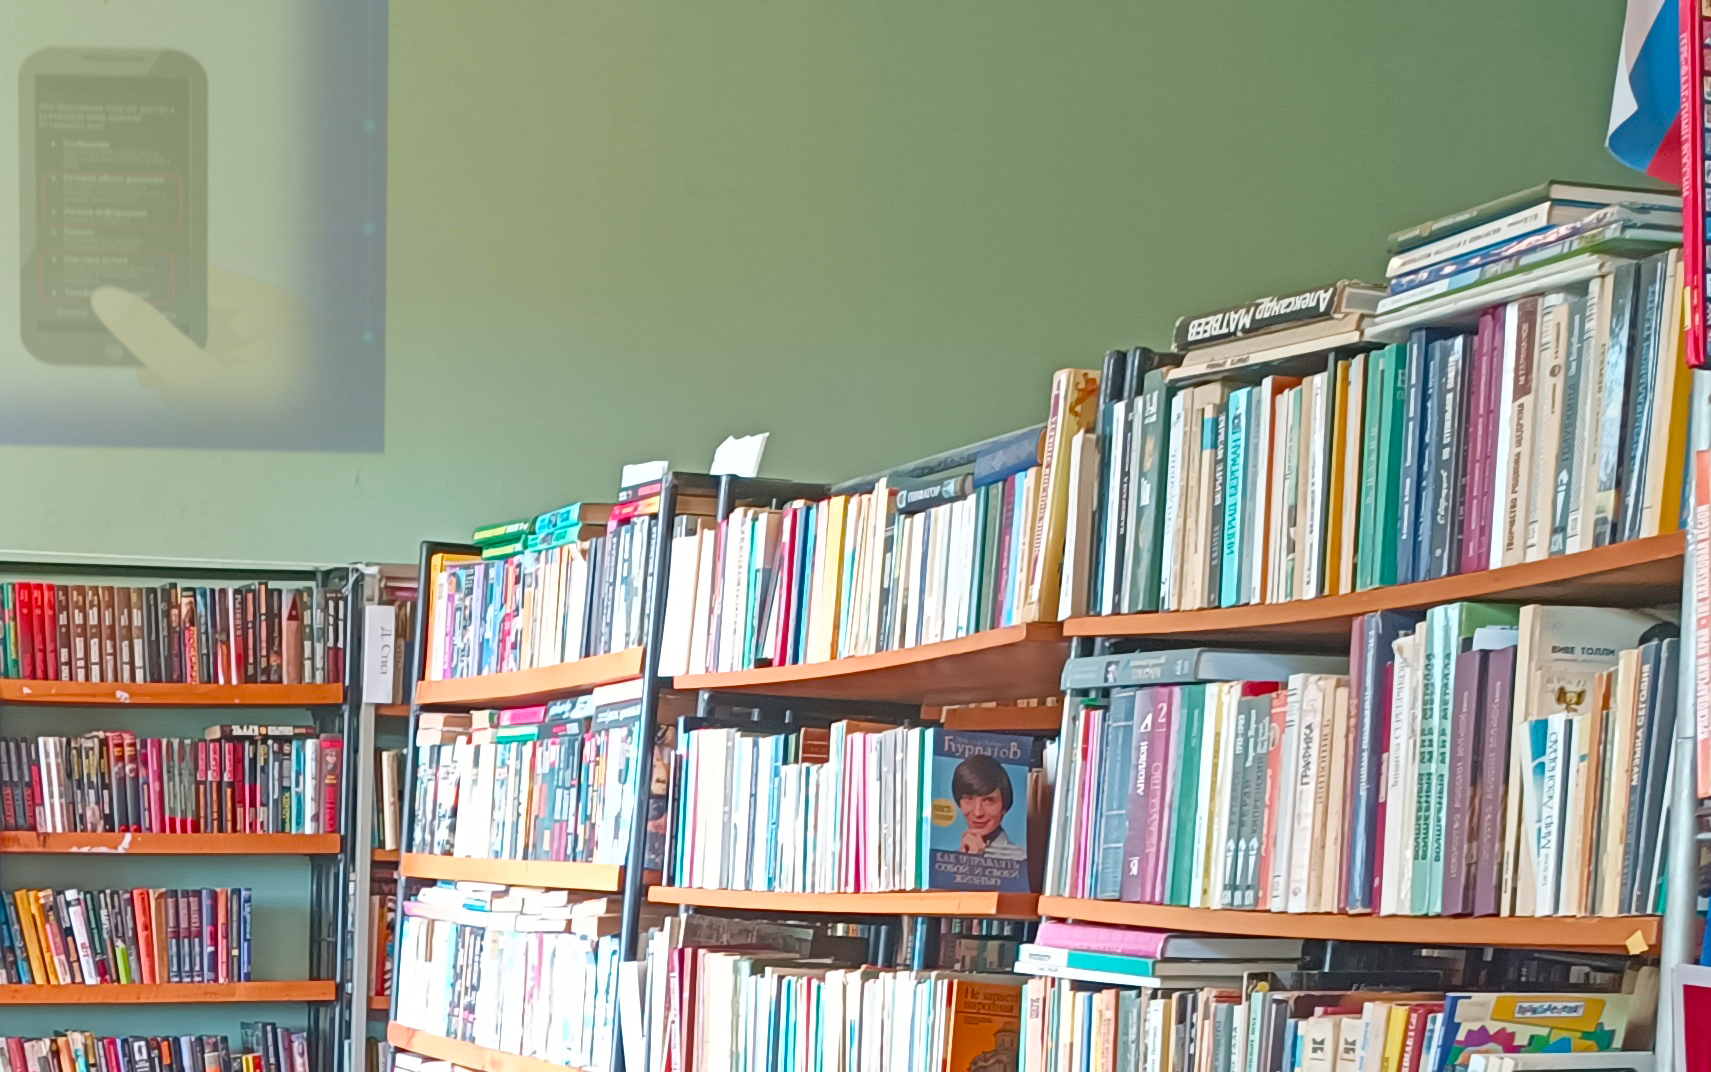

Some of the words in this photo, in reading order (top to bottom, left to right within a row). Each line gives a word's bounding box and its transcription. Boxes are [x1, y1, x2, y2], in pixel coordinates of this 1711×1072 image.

[1188, 306, 1254, 341] МАТВЕЕВ
[1255, 288, 1334, 321] Александр
[1642, 283, 1656, 337] ТЕАТРЕ
[1514, 403, 1525, 448] ЩЕДРИНА
[1561, 383, 1576, 462] ГОЛУБКИНА
[1229, 438, 1241, 497] БЕРГМАН
[1510, 451, 1522, 494] РОДИОНА
[1226, 501, 1238, 555] ИНГРИД
[1506, 498, 1517, 552] ТВОРЧЕСТВО
[1393, 656, 1409, 740] СЕРЕБРЯКОВ
[1636, 664, 1651, 726] СЕГОДНЯ
[1136, 742, 1148, 795] АПОЛЛОН
[1300, 722, 1313, 786] ГРАФИКА
[1542, 731, 1558, 810] Леонардо
[1631, 728, 1644, 786] МУЗЫКА
[1540, 814, 1554, 850] Мир
